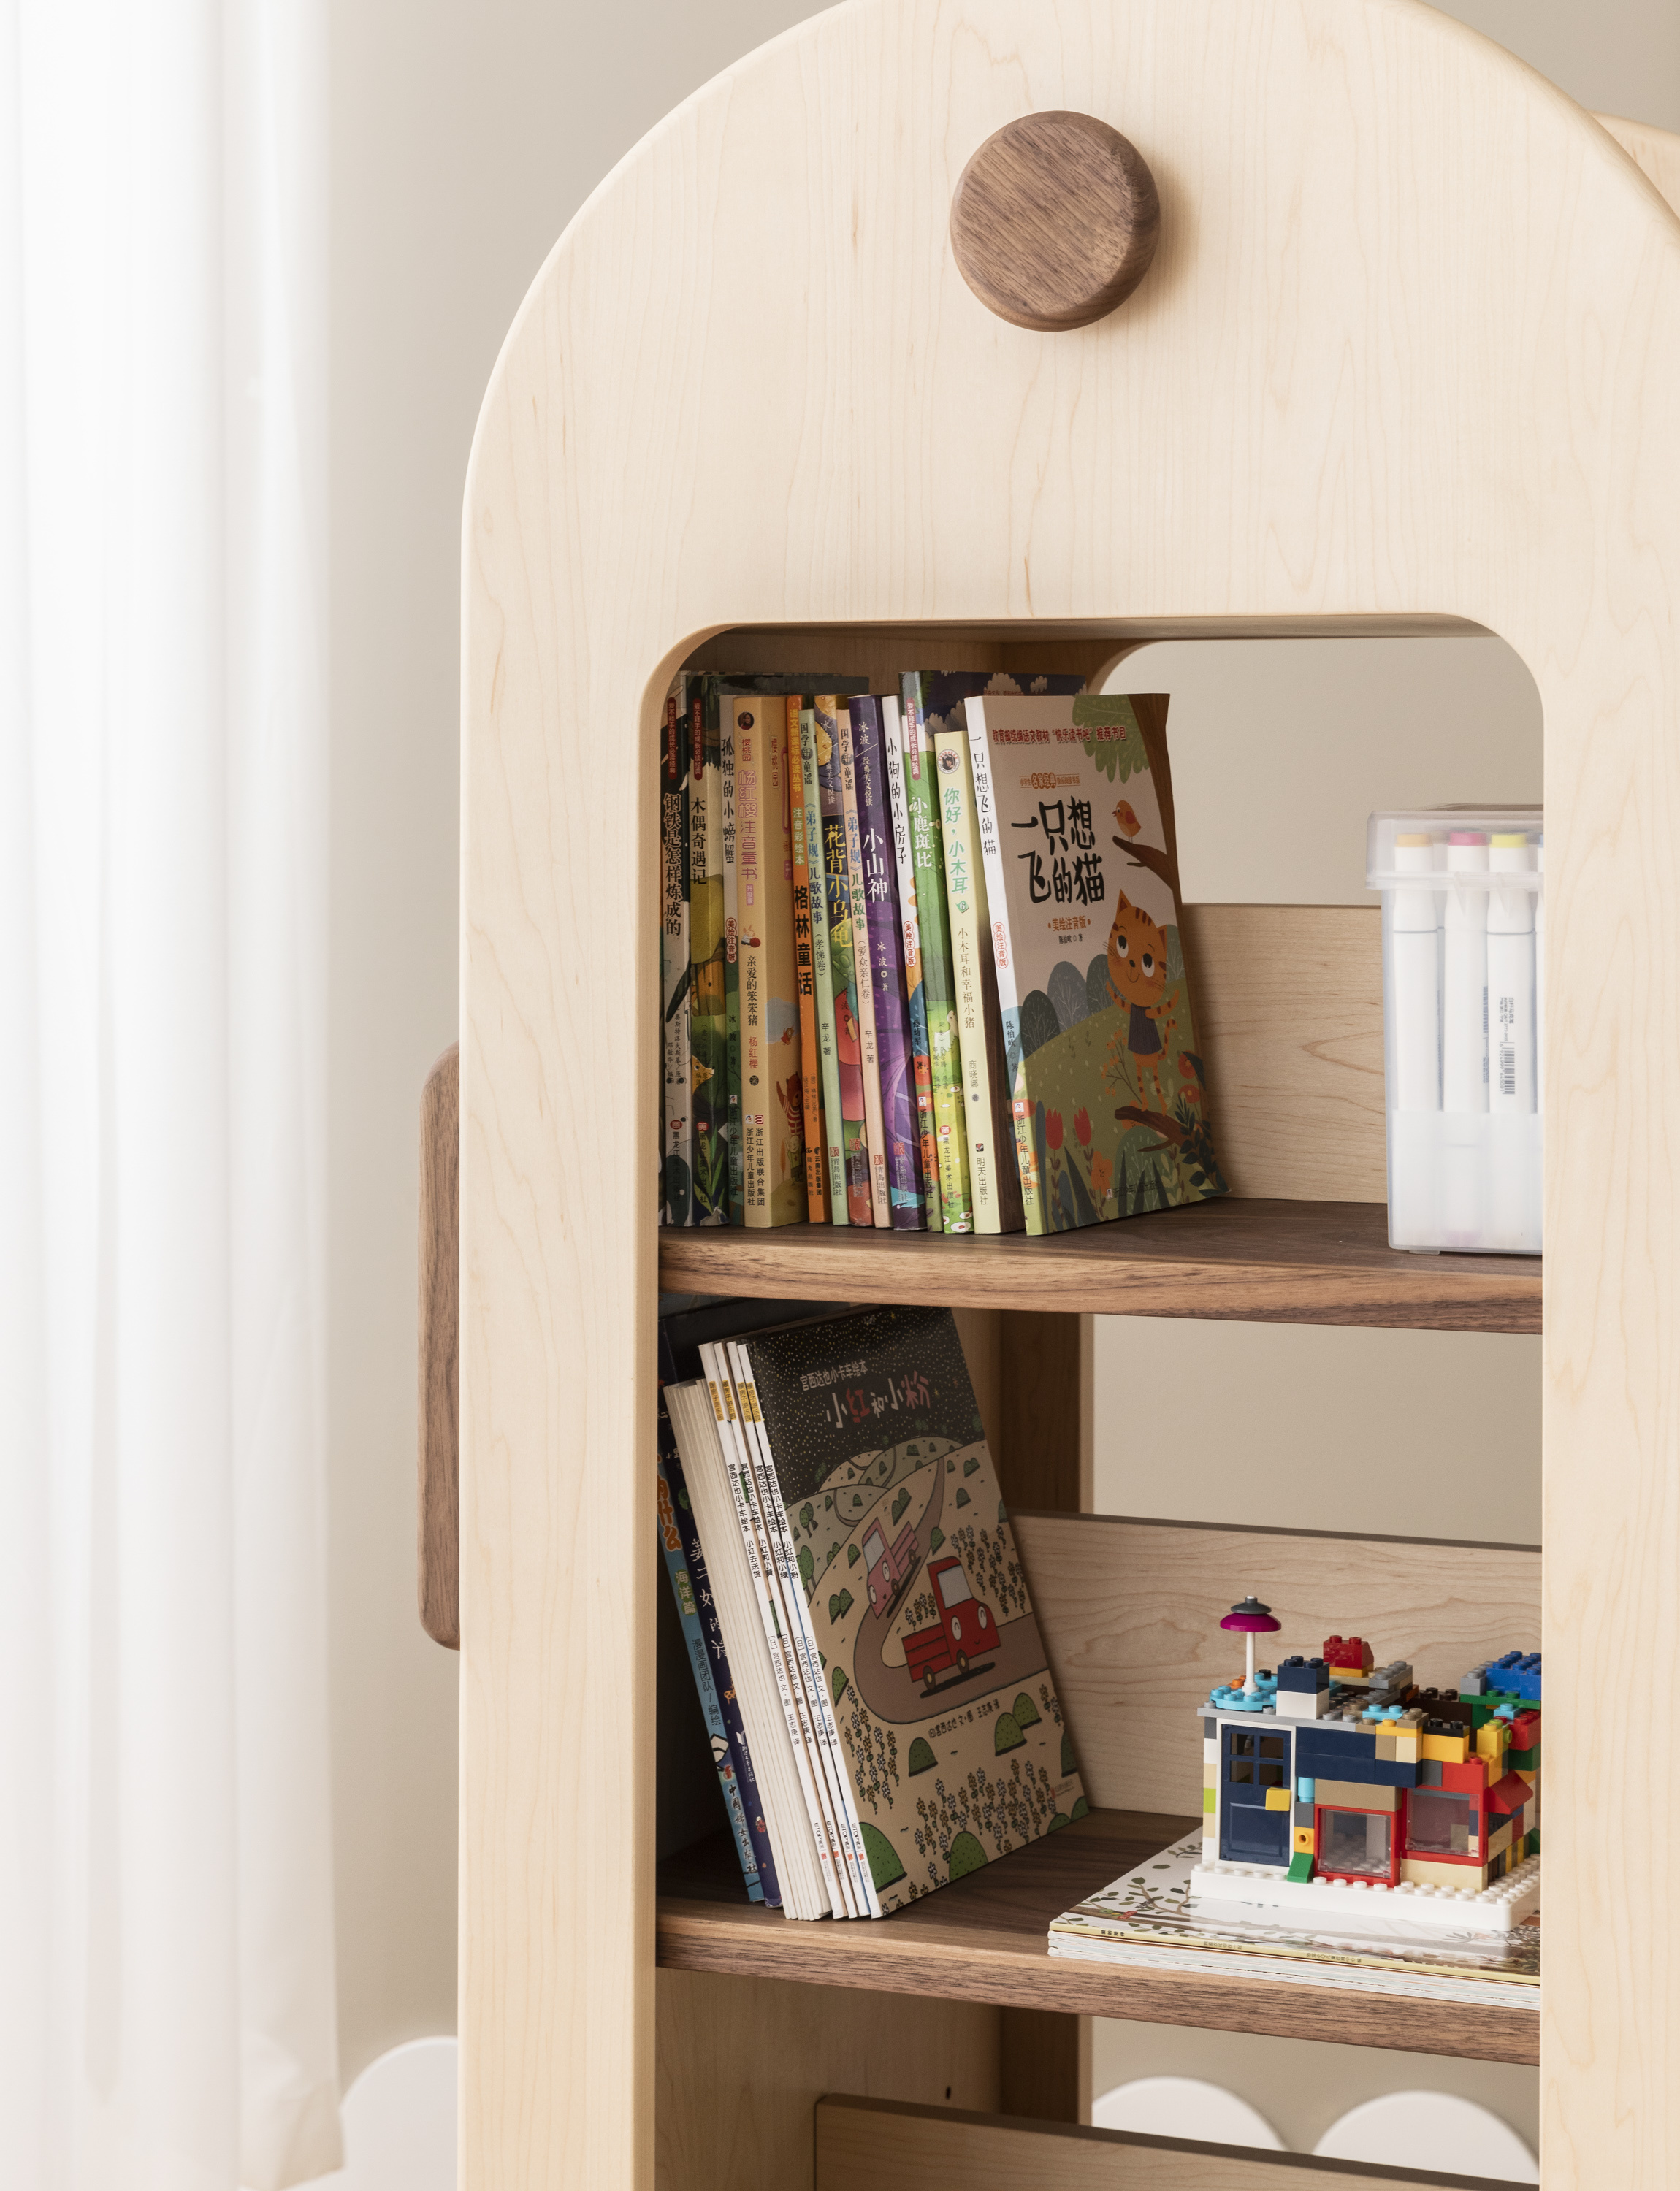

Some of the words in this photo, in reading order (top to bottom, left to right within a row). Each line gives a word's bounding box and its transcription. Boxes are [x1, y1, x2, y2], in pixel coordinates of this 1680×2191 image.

[668, 703, 676, 774] 爱不释手的成长必读经典
[694, 703, 702, 774] 爱不释手的成长必读经典
[741, 739, 752, 762] 樱桃园
[800, 722, 814, 785] 国学新童谣
[841, 728, 854, 791] 国学新童谣
[858, 721, 869, 745] 冰波
[906, 703, 920, 775] 爱不释手的成长必读经典
[721, 736, 736, 864] 孤独的小螃蟹
[863, 757, 873, 806] 经典美文悦读
[887, 738, 906, 865] 小狗的小房子
[969, 737, 996, 856] 一只想飞的猫
[690, 797, 707, 885] 木偶奇遇记
[793, 808, 804, 865] 注音彩绘本
[909, 798, 933, 868] 小鹿斑比
[1011, 795, 1096, 856] 一只想
[664, 793, 681, 936] 钢铁是怎样炼成的
[824, 825, 853, 948] 花背小乌龟
[863, 828, 887, 902] 小山神
[1017, 851, 1105, 906] 飞的猫
[727, 921, 736, 961] 美绘注音版
[794, 886, 812, 995] 格林童话
[960, 901, 966, 911] 6
[1052, 916, 1087, 931] 美绘注音版
[905, 923, 915, 966] 美绘注音版
[958, 928, 974, 1028] 小木耳和幸福小猪
[994, 924, 1007, 967] 美绘注音版
[747, 955, 758, 1027] 亲爱的笨笨猪
[748, 1036, 758, 1068] 杨红樱
[1006, 1021, 1016, 1047] 陈伯吹
[969, 1060, 979, 1087] 商晓娜
[746, 1128, 755, 1206] 浙江少年儿童出版社
[755, 1128, 765, 1206] 浙江出版联合集团
[833, 1157, 843, 1196] 青岛出版社
[878, 1166, 887, 1204] 青岛出版社
[920, 1109, 933, 1198] 浙江少年儿童出版社
[943, 1137, 955, 1208] 黑龙江美术出版社
[977, 1158, 988, 1205] 明天出版社
[1016, 1115, 1034, 1205] 浙江少年儿童出版社
[800, 1361, 868, 1391] 宫西达也小卡车绘本
[826, 1371, 931, 1428] 小红和小粉
[728, 1464, 750, 1532] 宫西达也小卡车绘本
[746, 1540, 761, 1578] 小红去送货
[741, 1463, 763, 1531] 宫西达也小卡车绘本
[759, 1539, 774, 1577] 小红和小黄
[755, 1465, 777, 1533] 宫西达也小卡车绘本
[774, 1541, 789, 1579] 小红和小绿
[766, 1465, 787, 1533] 宫西达也小卡车绘本
[783, 1541, 798, 1578] 小红和小粉
[676, 1572, 696, 1615] 海洋篇
